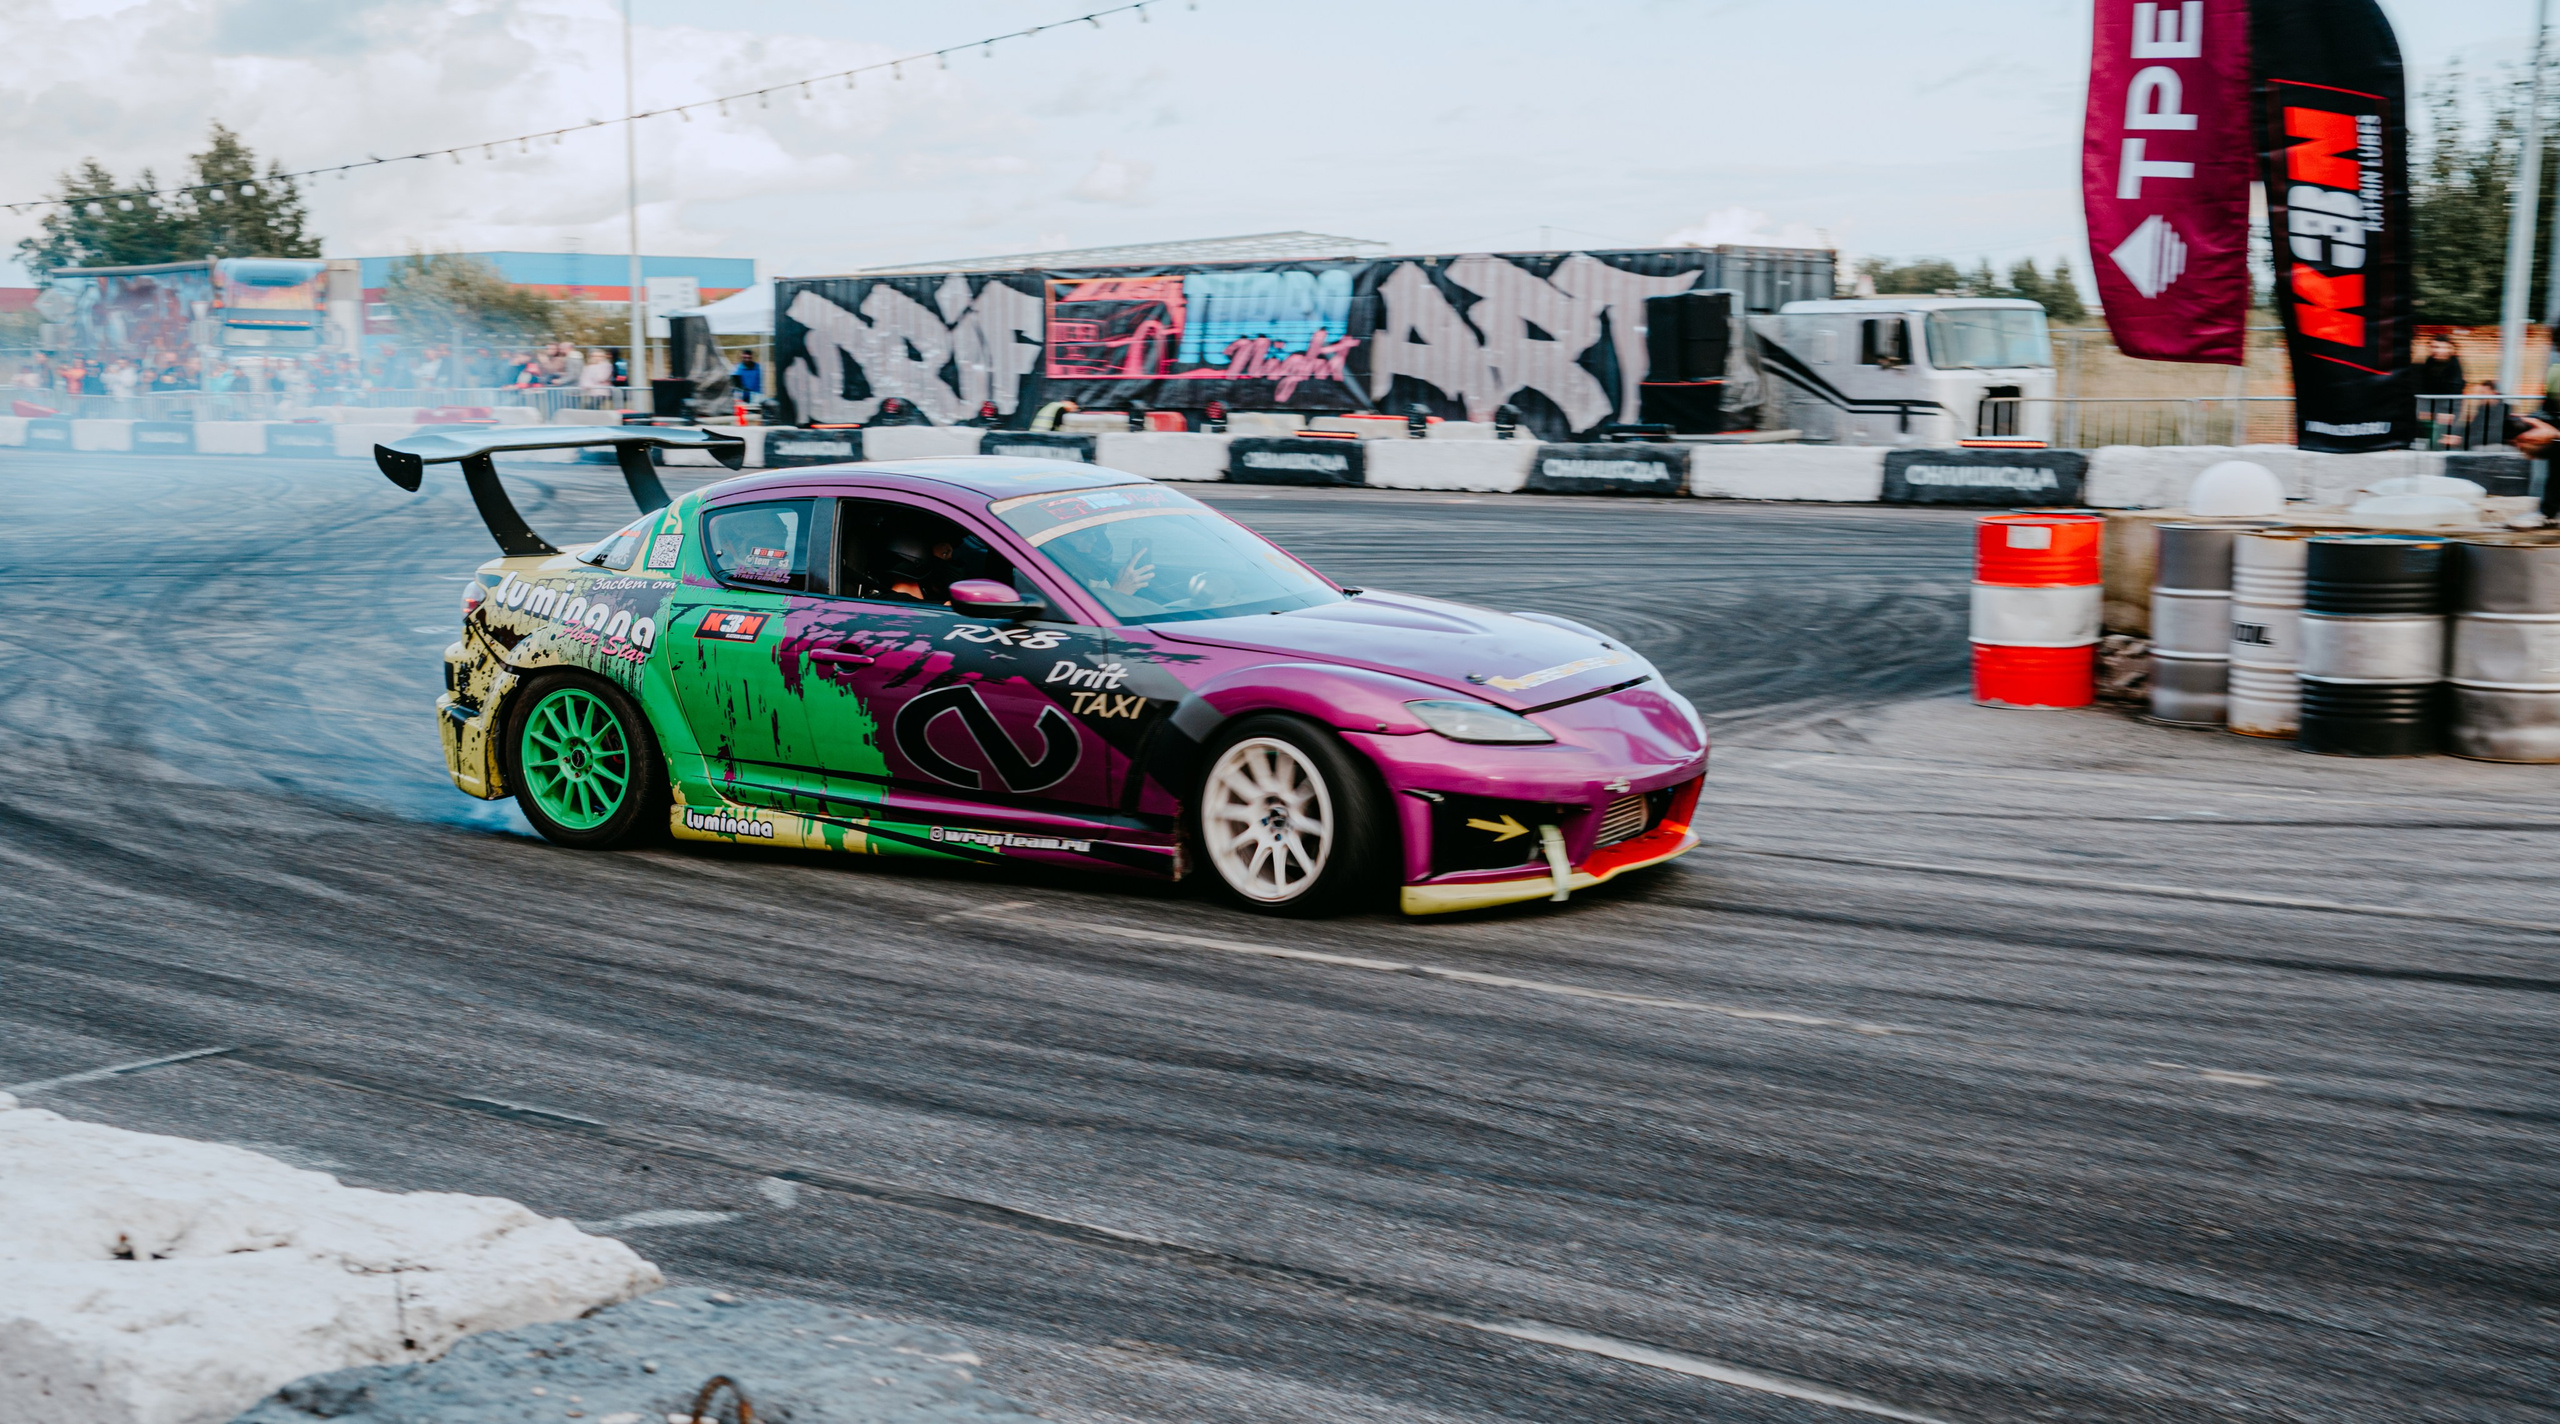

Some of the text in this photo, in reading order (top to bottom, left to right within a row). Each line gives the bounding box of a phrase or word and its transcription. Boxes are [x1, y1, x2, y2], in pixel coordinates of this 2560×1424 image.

[2284, 106, 2366, 348] K3N
[495, 571, 656, 650] Luminana
[701, 612, 764, 635] K3N
[601, 636, 646, 665] Star
[943, 624, 1071, 649] RX-8
[1045, 660, 1129, 690] Drift
[1070, 692, 1147, 719] TAXI
[686, 808, 774, 838] Luminana
